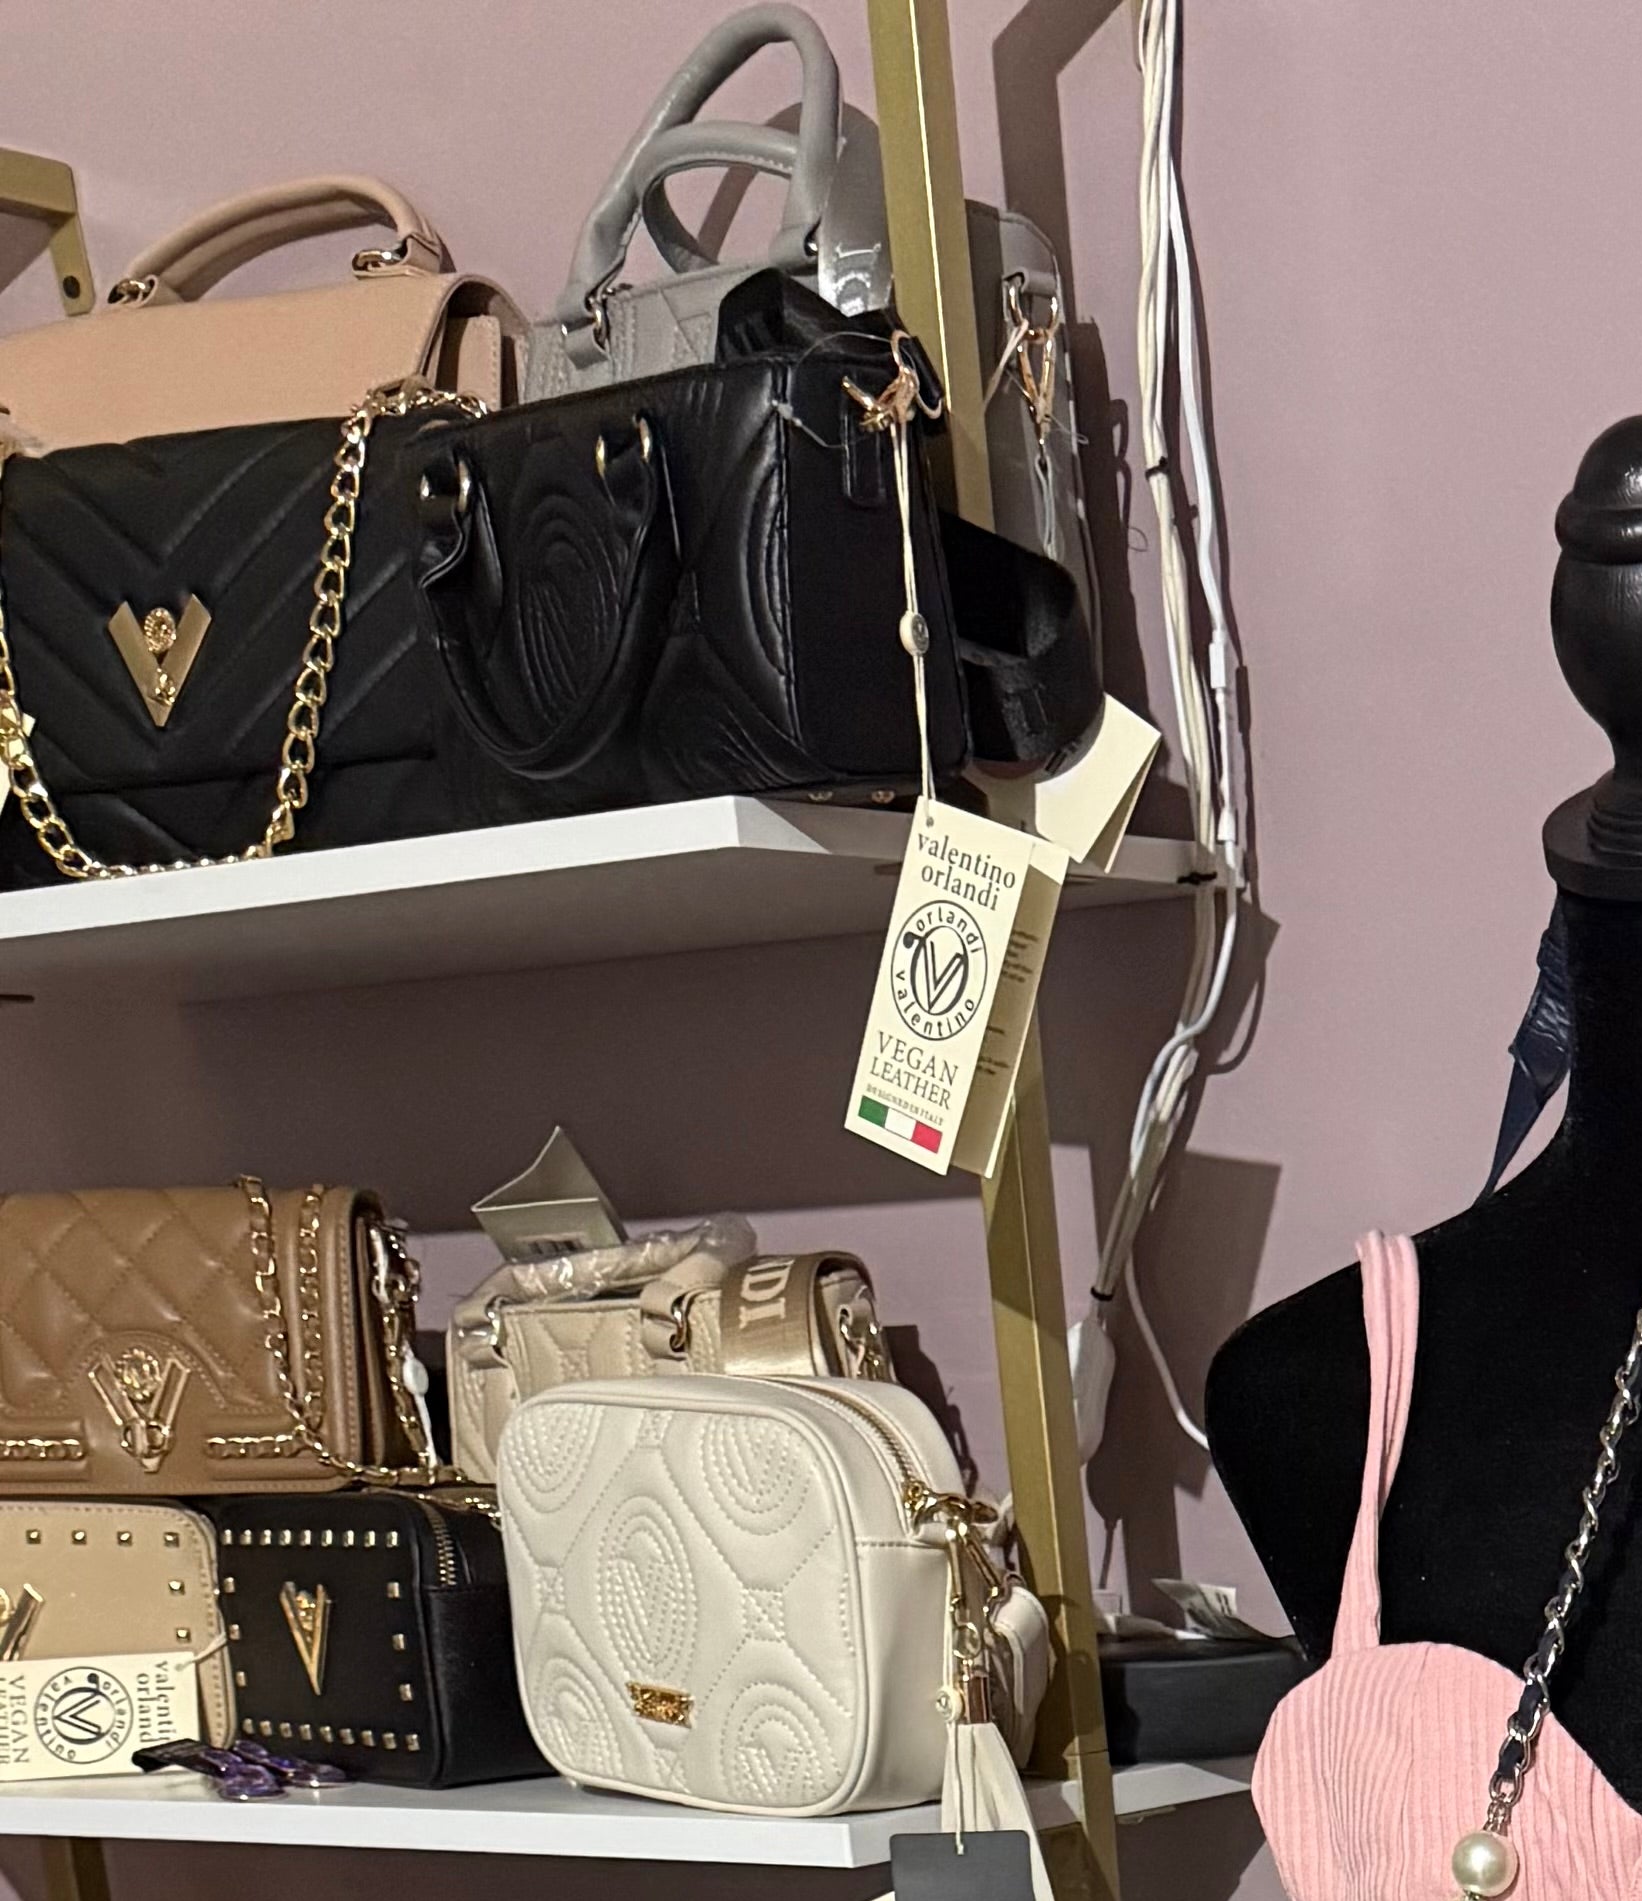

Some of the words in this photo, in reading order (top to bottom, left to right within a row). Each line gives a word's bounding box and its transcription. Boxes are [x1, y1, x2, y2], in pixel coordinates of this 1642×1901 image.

[916, 831, 1017, 890] valentino
[921, 863, 1001, 911] orlandi
[916, 906, 984, 955] orlandi
[896, 969, 976, 1038] valentino
[870, 1056, 952, 1111] LEATHER
[877, 1030, 959, 1087] VEGAN
[8, 1674, 30, 1764] VEGAN
[136, 1672, 156, 1744] orland
[154, 1660, 177, 1741] valenti
